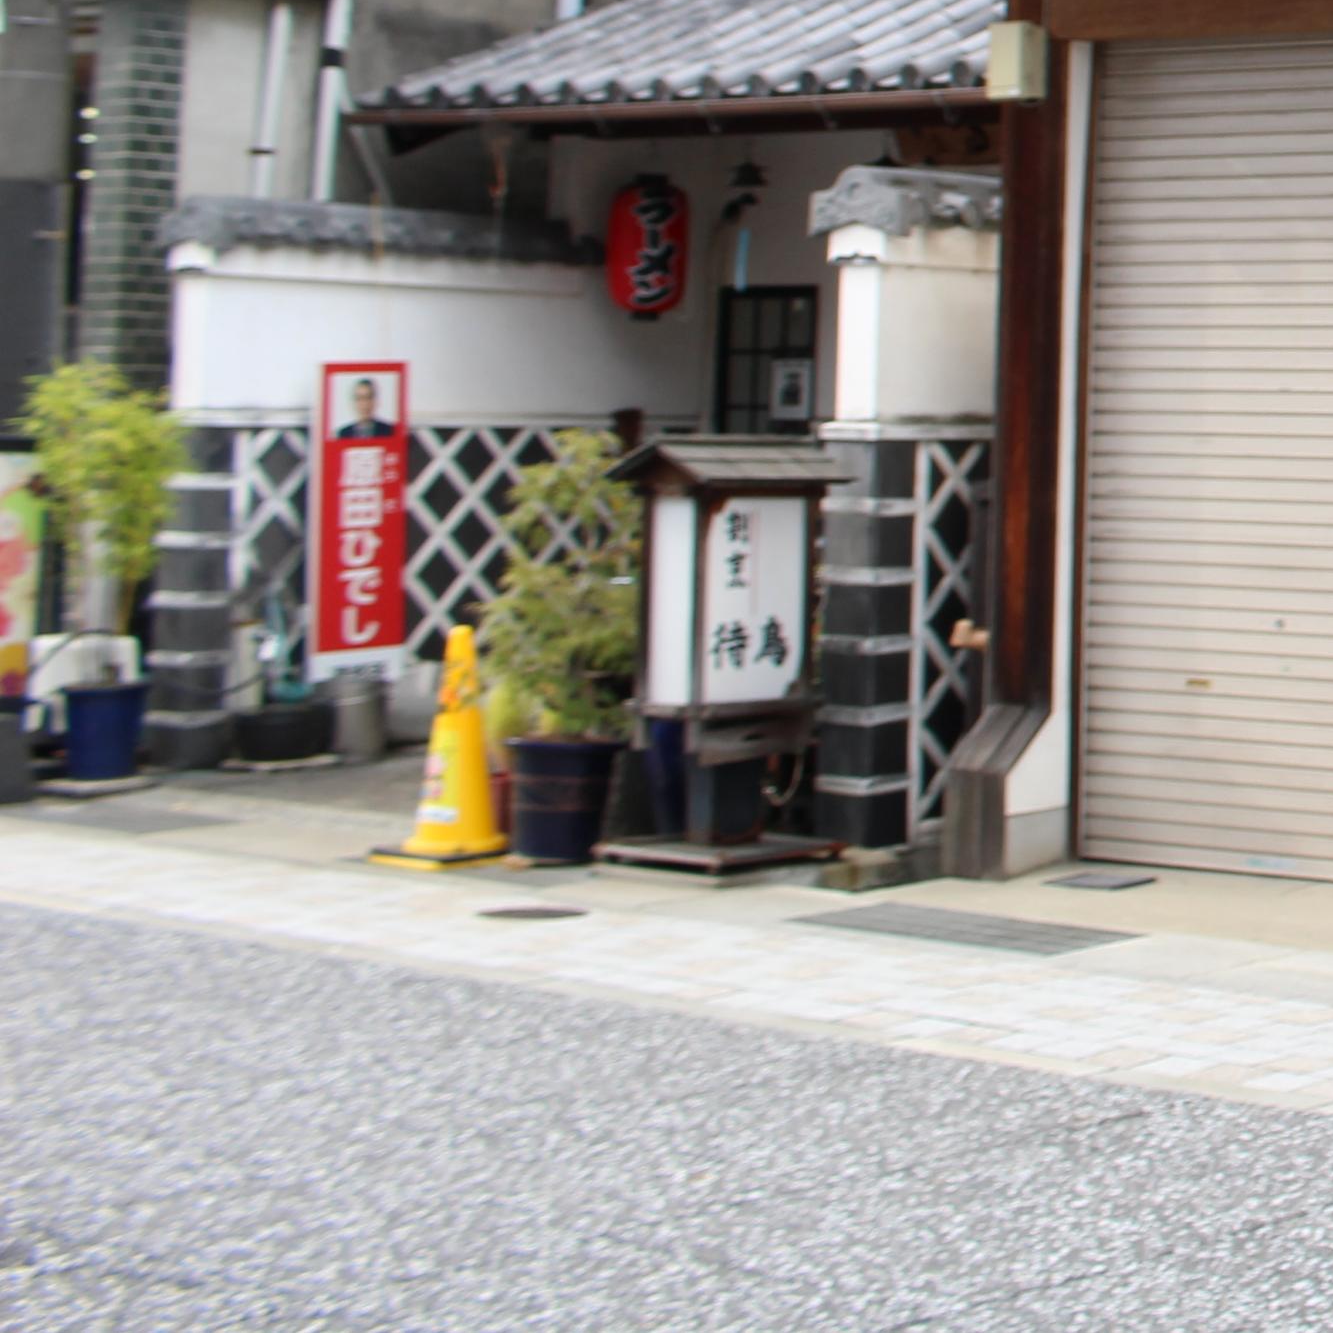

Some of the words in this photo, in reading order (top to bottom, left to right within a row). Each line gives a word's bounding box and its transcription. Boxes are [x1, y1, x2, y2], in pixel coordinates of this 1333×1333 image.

[626, 186, 675, 305] ラーメン
[338, 445, 385, 645] 原田ひでし
